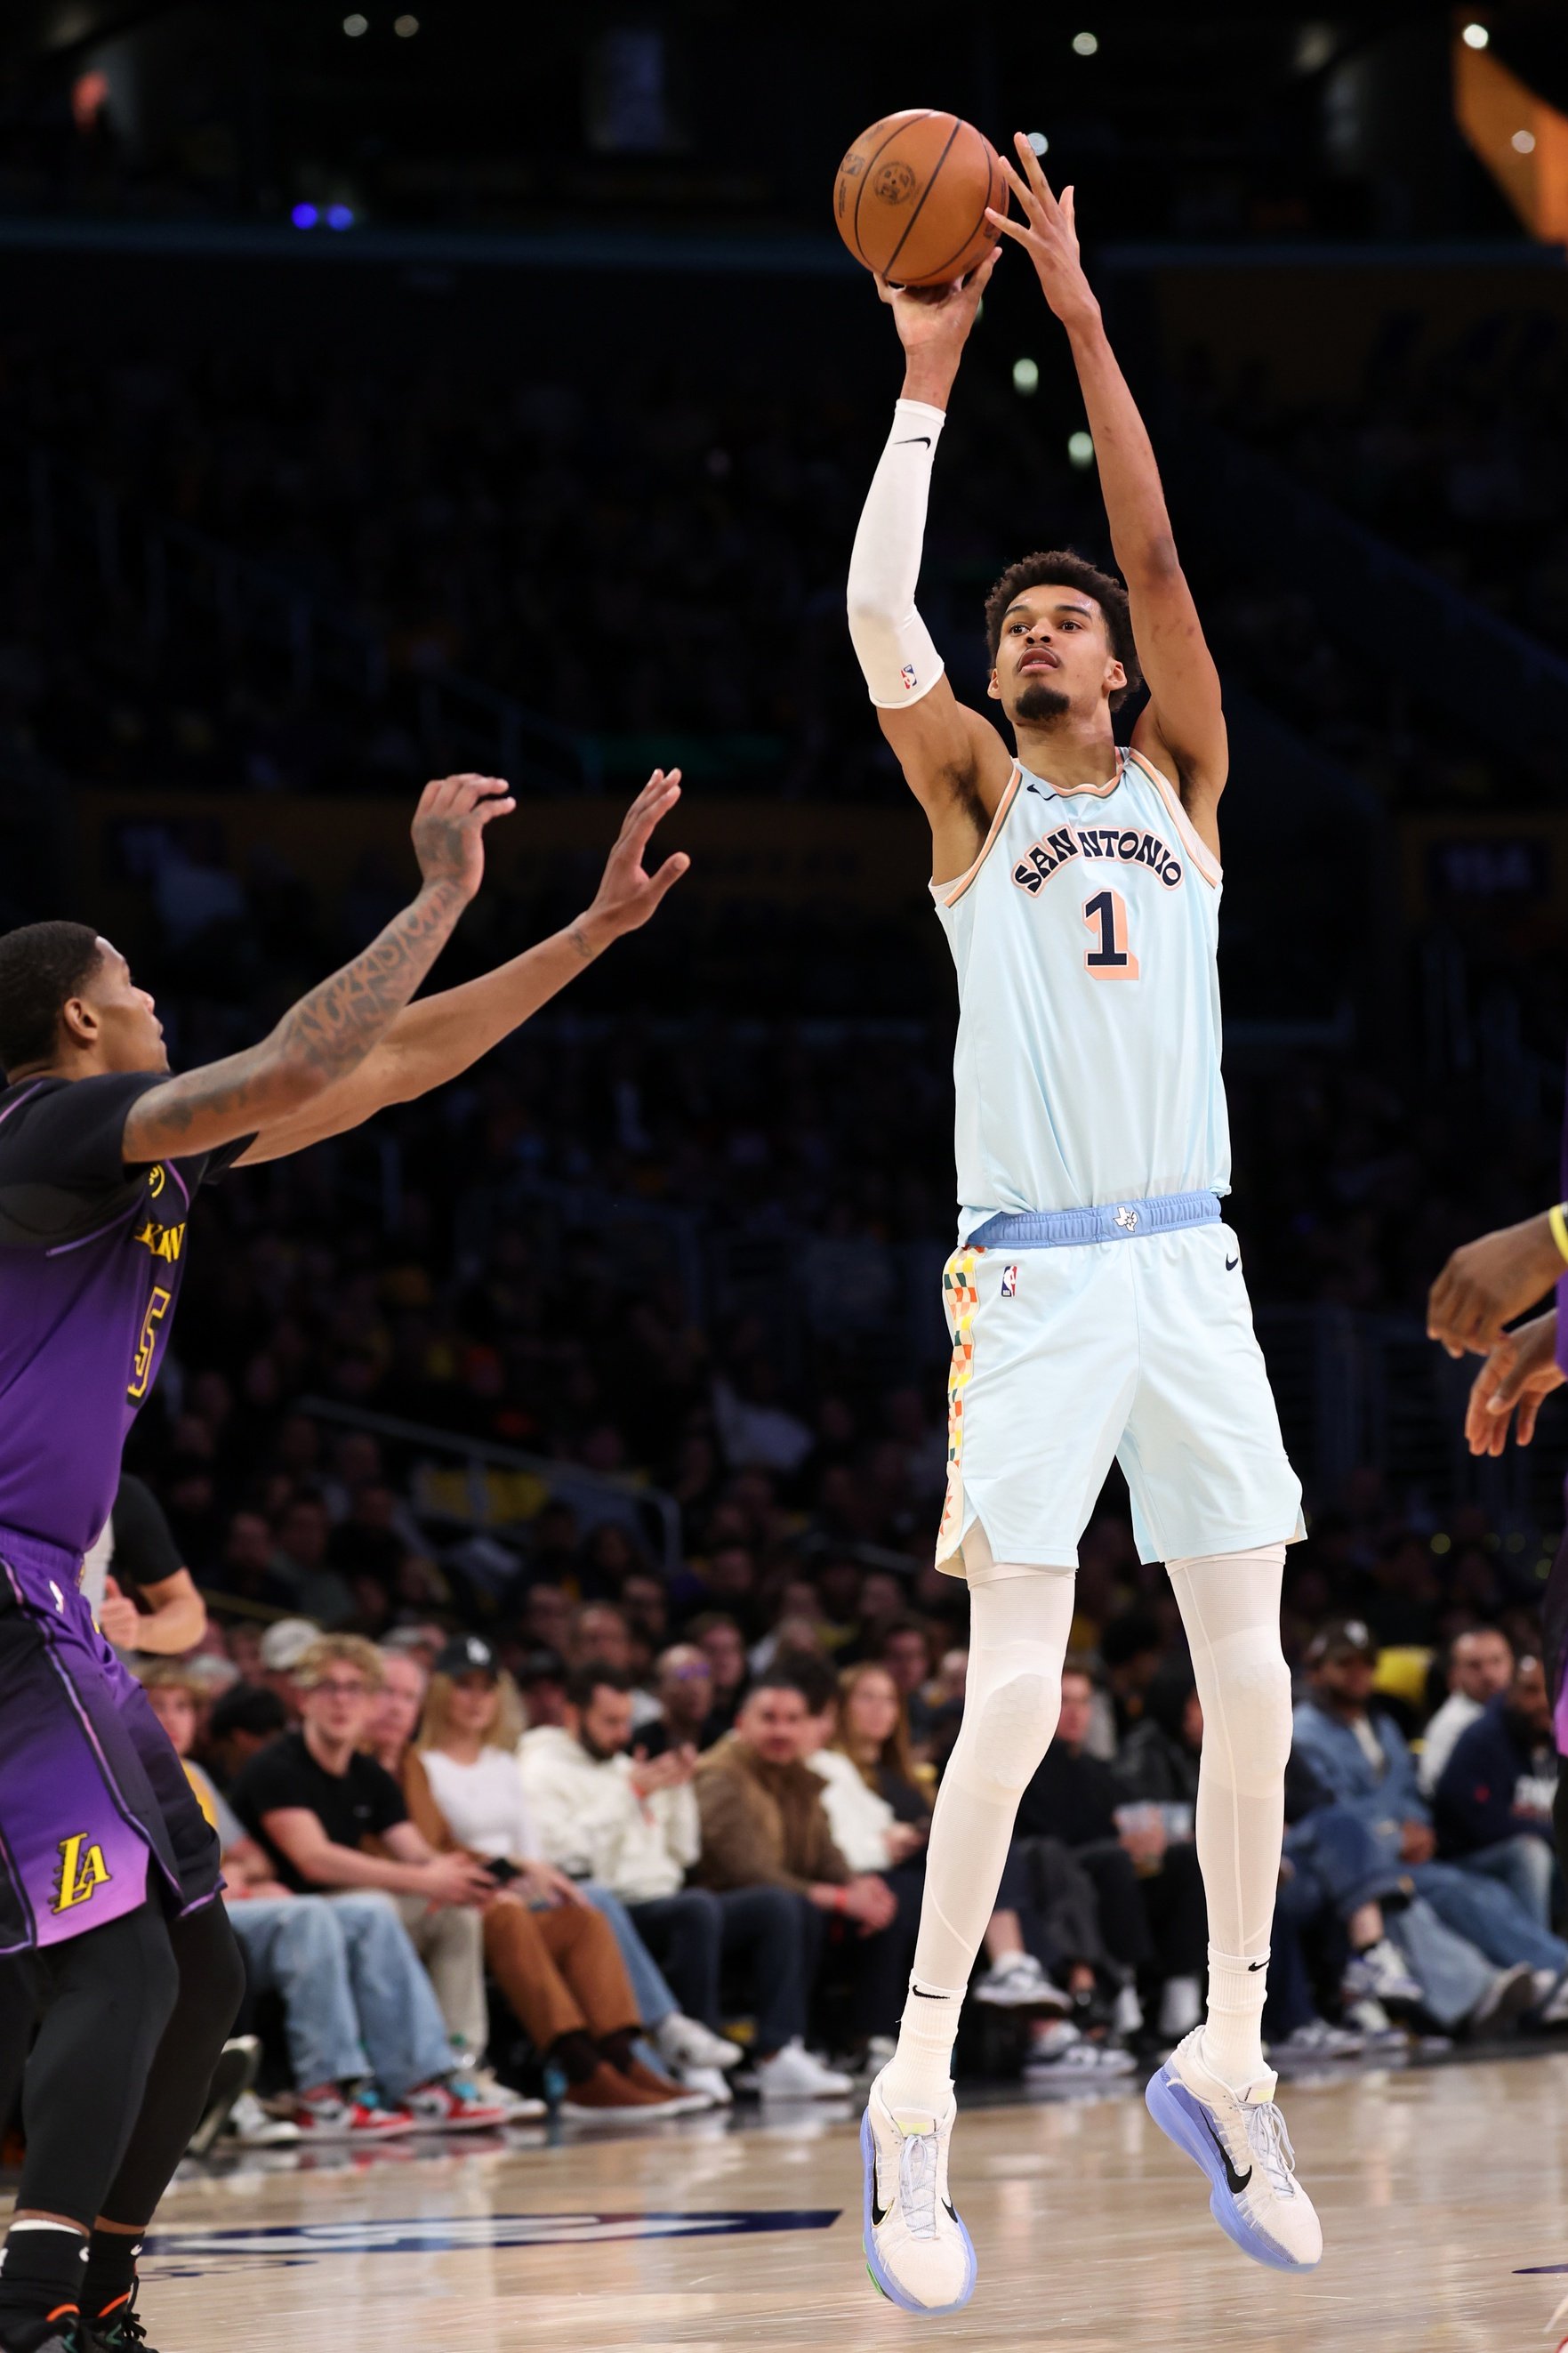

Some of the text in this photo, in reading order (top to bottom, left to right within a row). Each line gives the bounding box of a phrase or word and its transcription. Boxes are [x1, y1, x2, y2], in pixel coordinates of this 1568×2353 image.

[1013, 826, 1183, 894] SAN NTONIO
[1084, 890, 1129, 967] 1
[51, 1831, 112, 1914] LA
